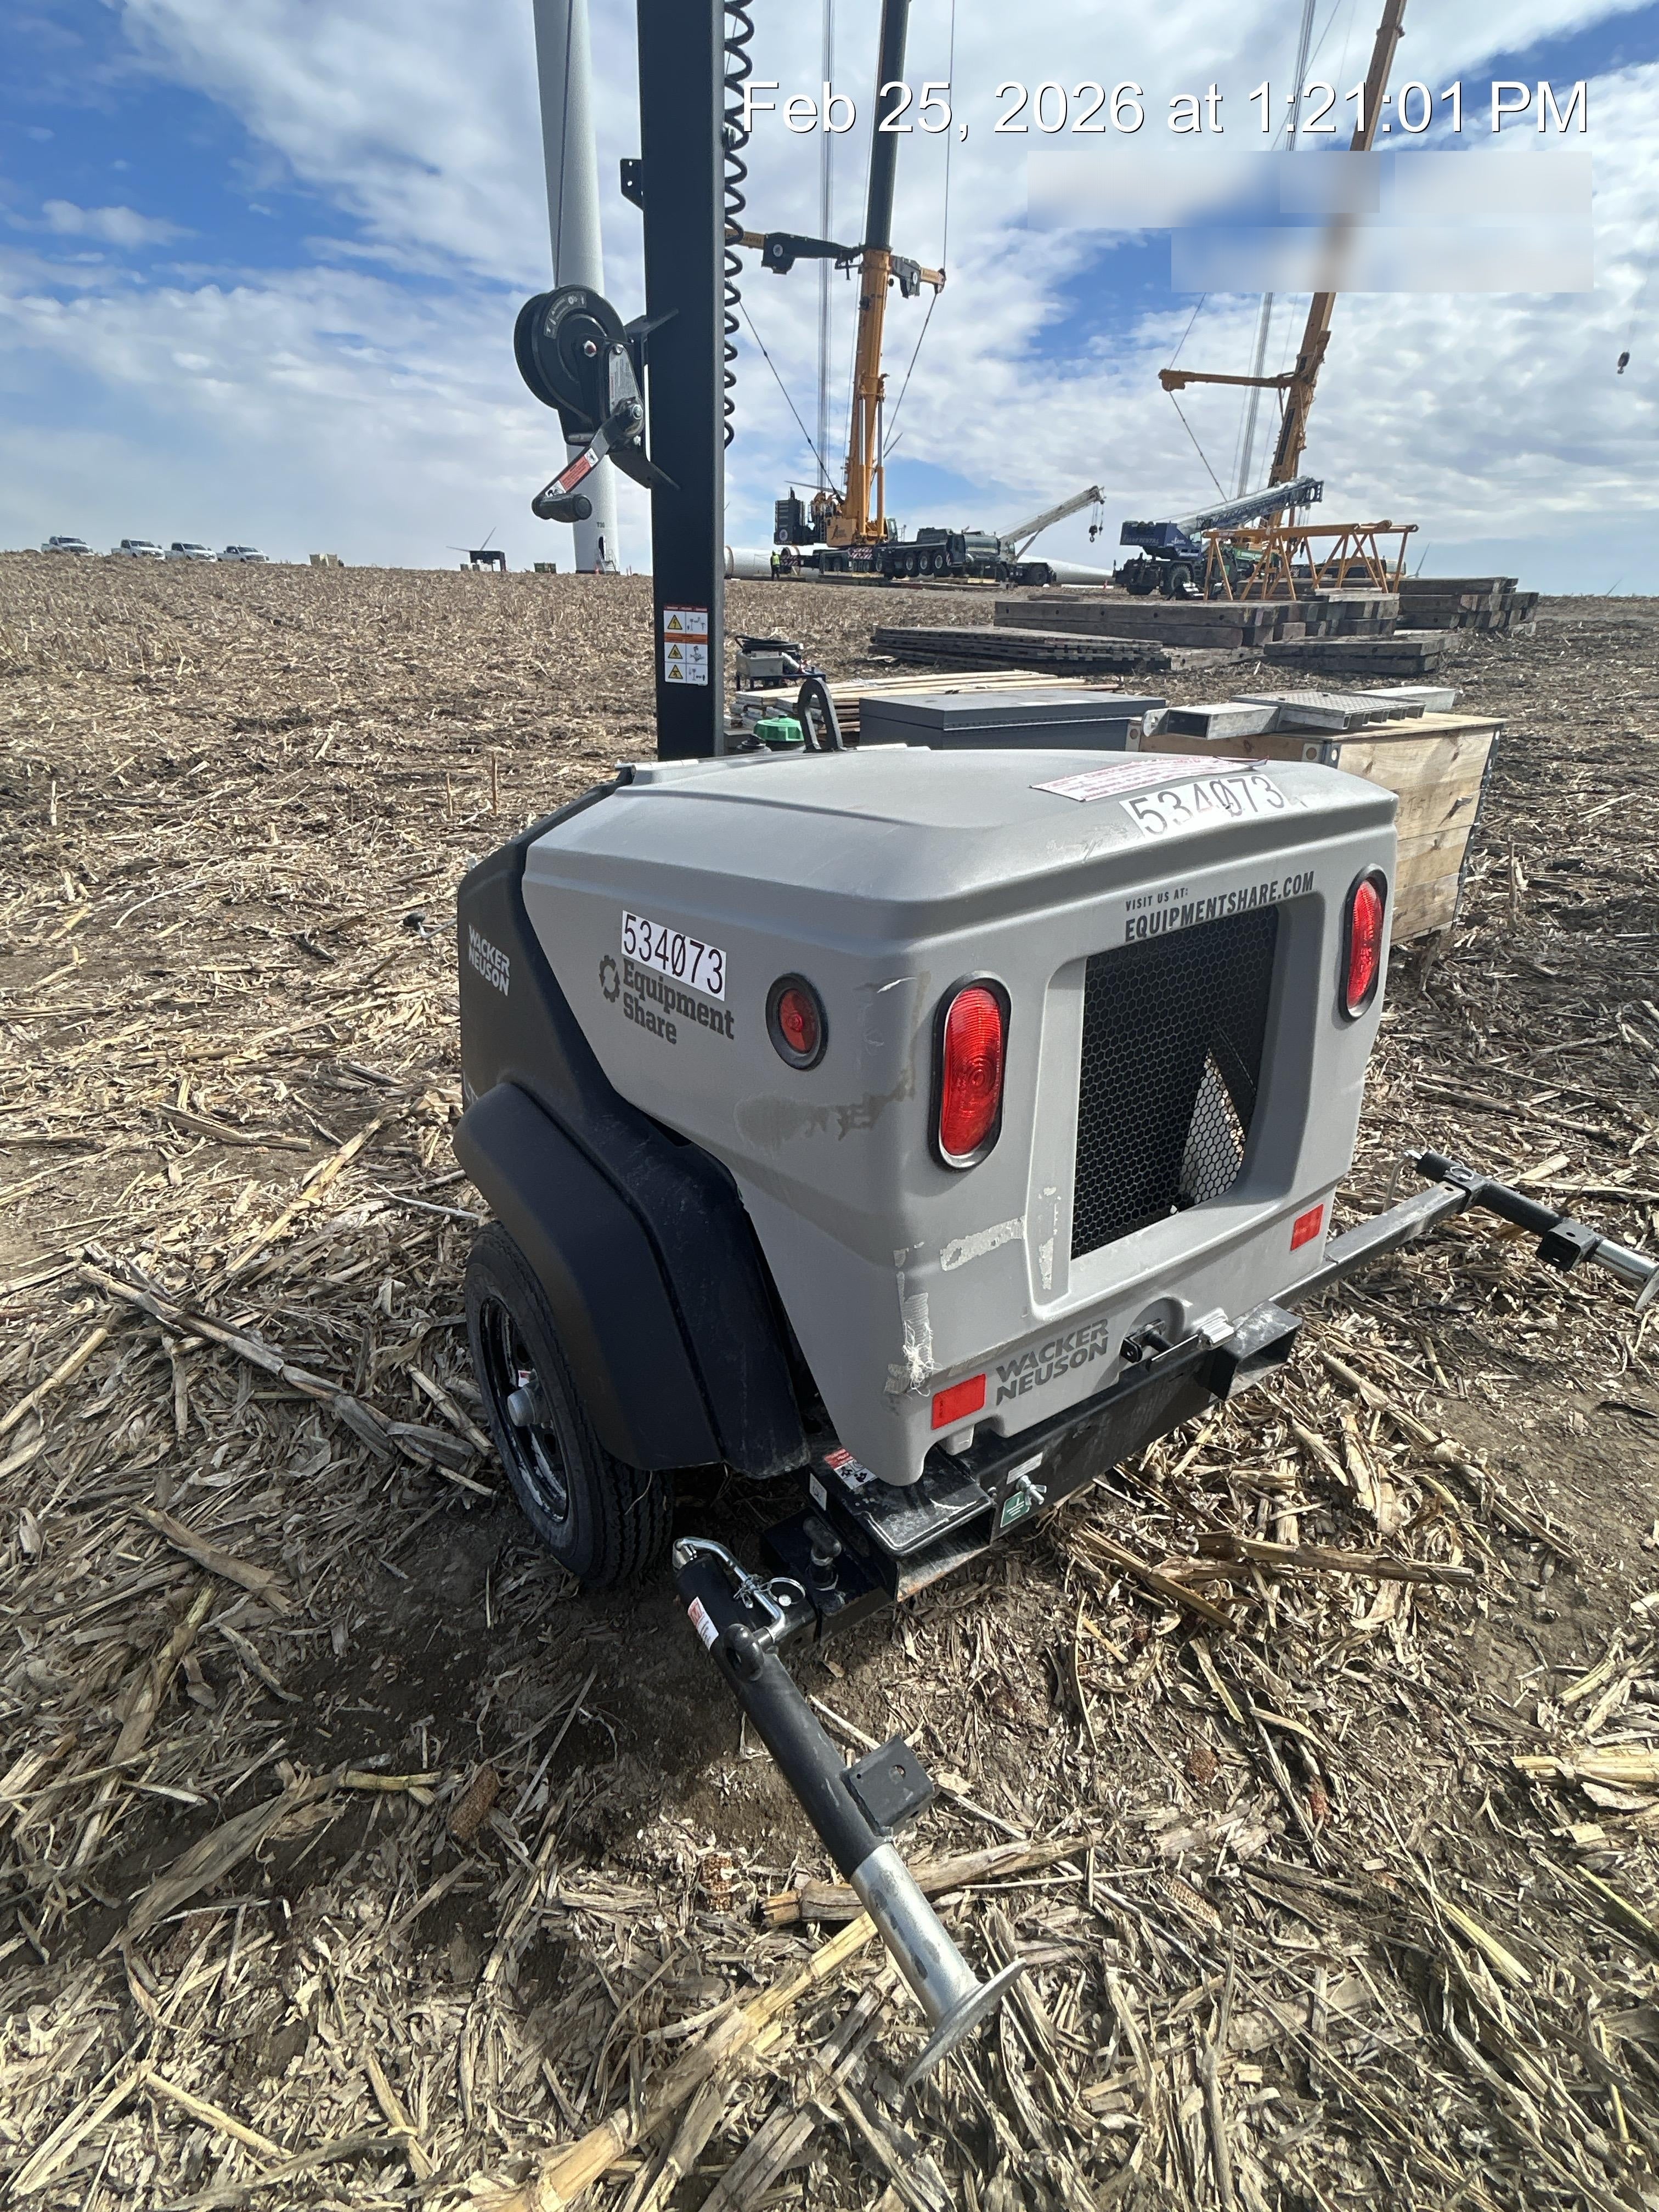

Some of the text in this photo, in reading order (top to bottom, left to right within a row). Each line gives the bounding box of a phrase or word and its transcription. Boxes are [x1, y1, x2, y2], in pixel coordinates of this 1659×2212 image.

[1128, 778, 1284, 836] 534073
[1125, 871, 1315, 942] EQUIPMENTSHARE.COM
[1126, 888, 1188, 911] VISIT US AT:
[468, 923, 510, 978] WACKER
[469, 944, 510, 996] NEUSON
[623, 913, 723, 994] 534073
[623, 958, 735, 1040] Equipment
[623, 992, 677, 1045] Share
[995, 1318, 1109, 1383] WACKER
[996, 1336, 1108, 1406] NEUSON
